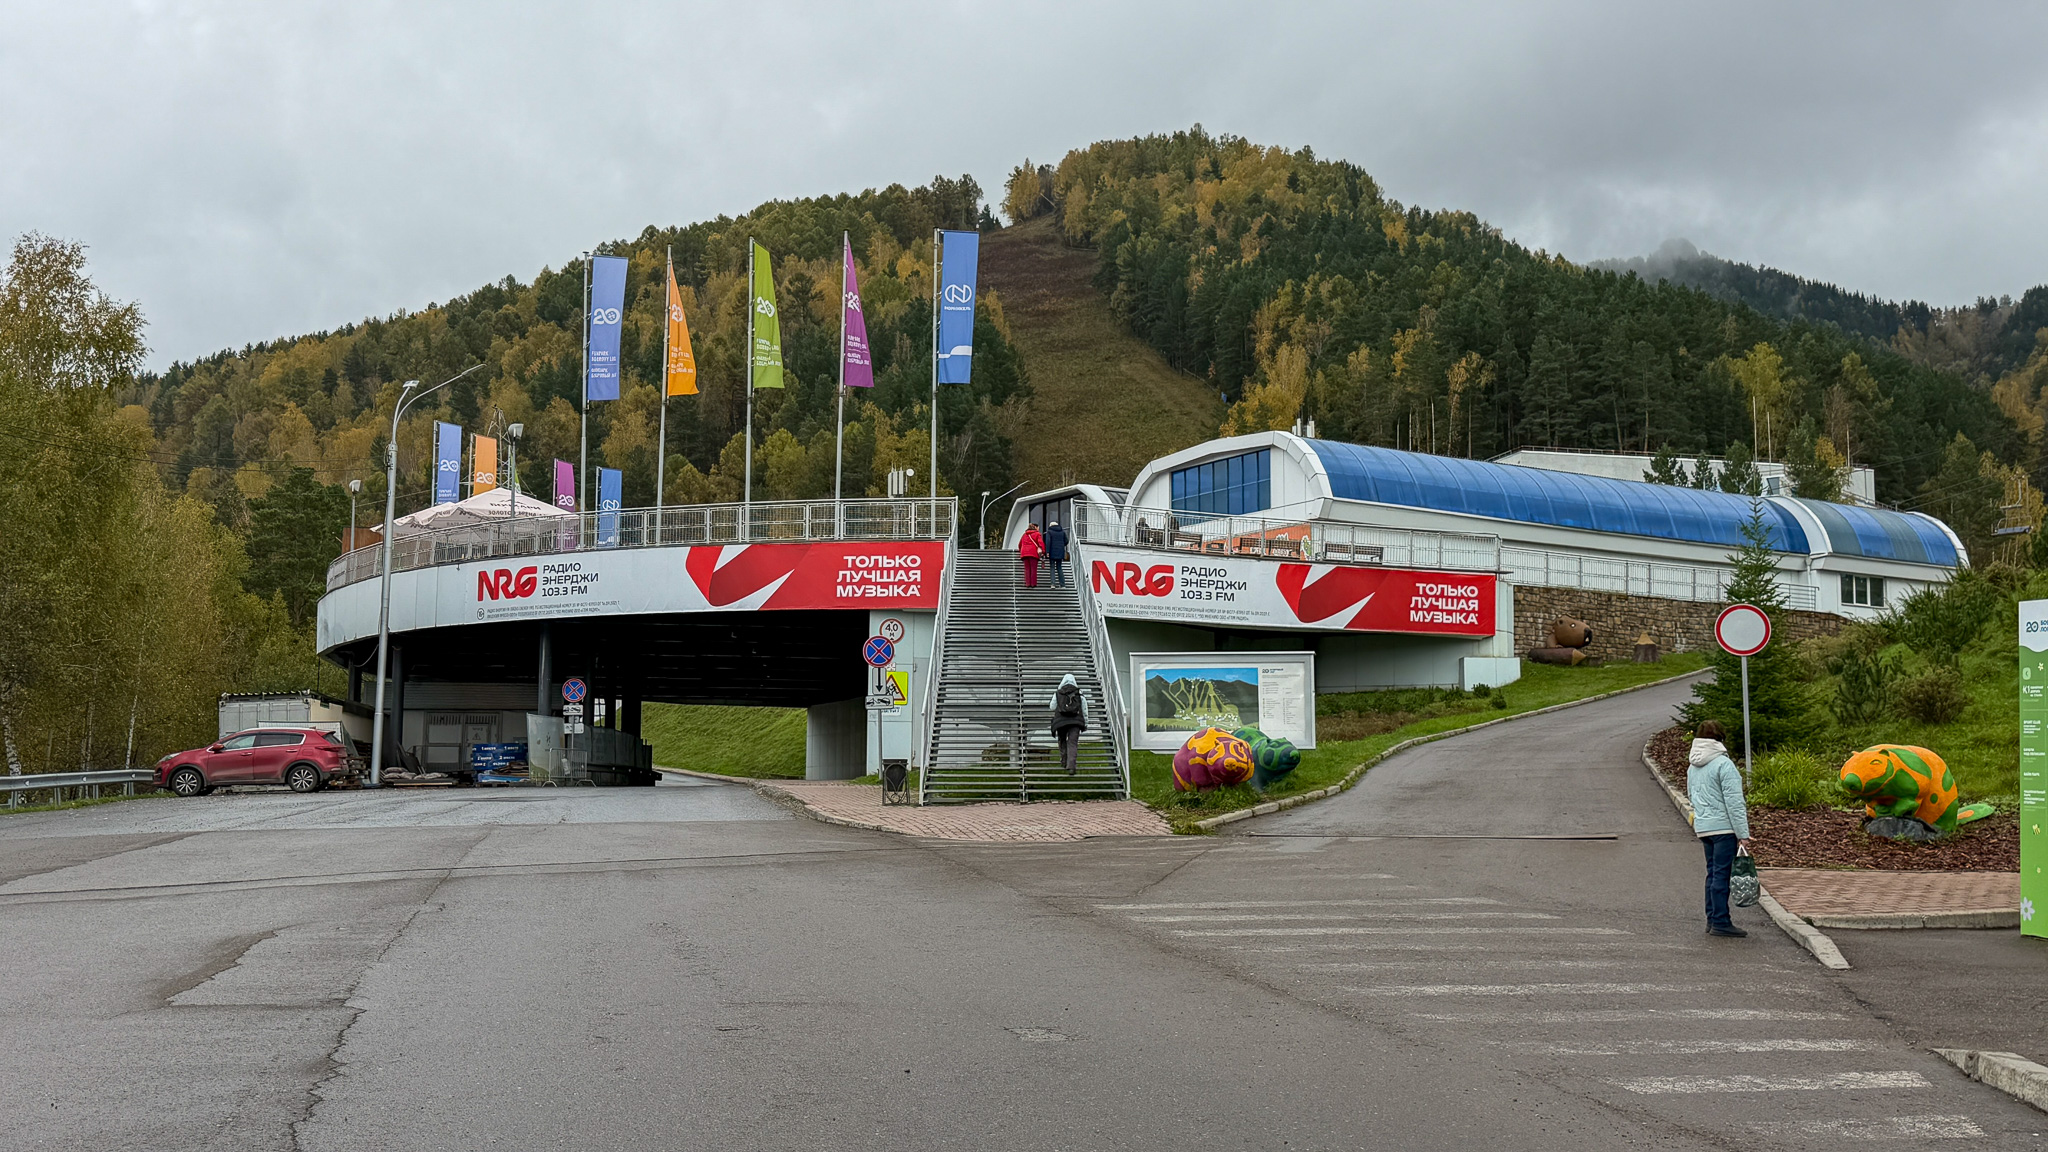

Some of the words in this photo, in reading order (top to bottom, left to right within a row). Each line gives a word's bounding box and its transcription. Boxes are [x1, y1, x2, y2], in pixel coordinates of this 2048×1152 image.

[593, 307, 621, 325] 20
[440, 459, 459, 473] 20
[476, 472, 494, 485] 20
[558, 494, 575, 507] 20
[843, 555, 921, 568] ТОЛЬКО
[542, 562, 582, 575] РАДИО
[1181, 566, 1227, 579] РАДИО
[542, 573, 599, 586] ЭНЕРДЖИ
[836, 570, 921, 583] ЛУЧШАЯ
[1092, 560, 1174, 597] NRG
[477, 566, 538, 602] NRG
[1180, 578, 1247, 592] ЭНЕРДЖИ
[1415, 583, 1478, 597] ТОЛЬКО
[542, 586, 568, 597] 103.3
[571, 585, 588, 595] FM
[1180, 590, 1213, 601] 103.3
[1216, 592, 1235, 602] FM
[1409, 596, 1478, 611] ЛУЧШАЯ
[2026, 621, 2039, 633] 20
